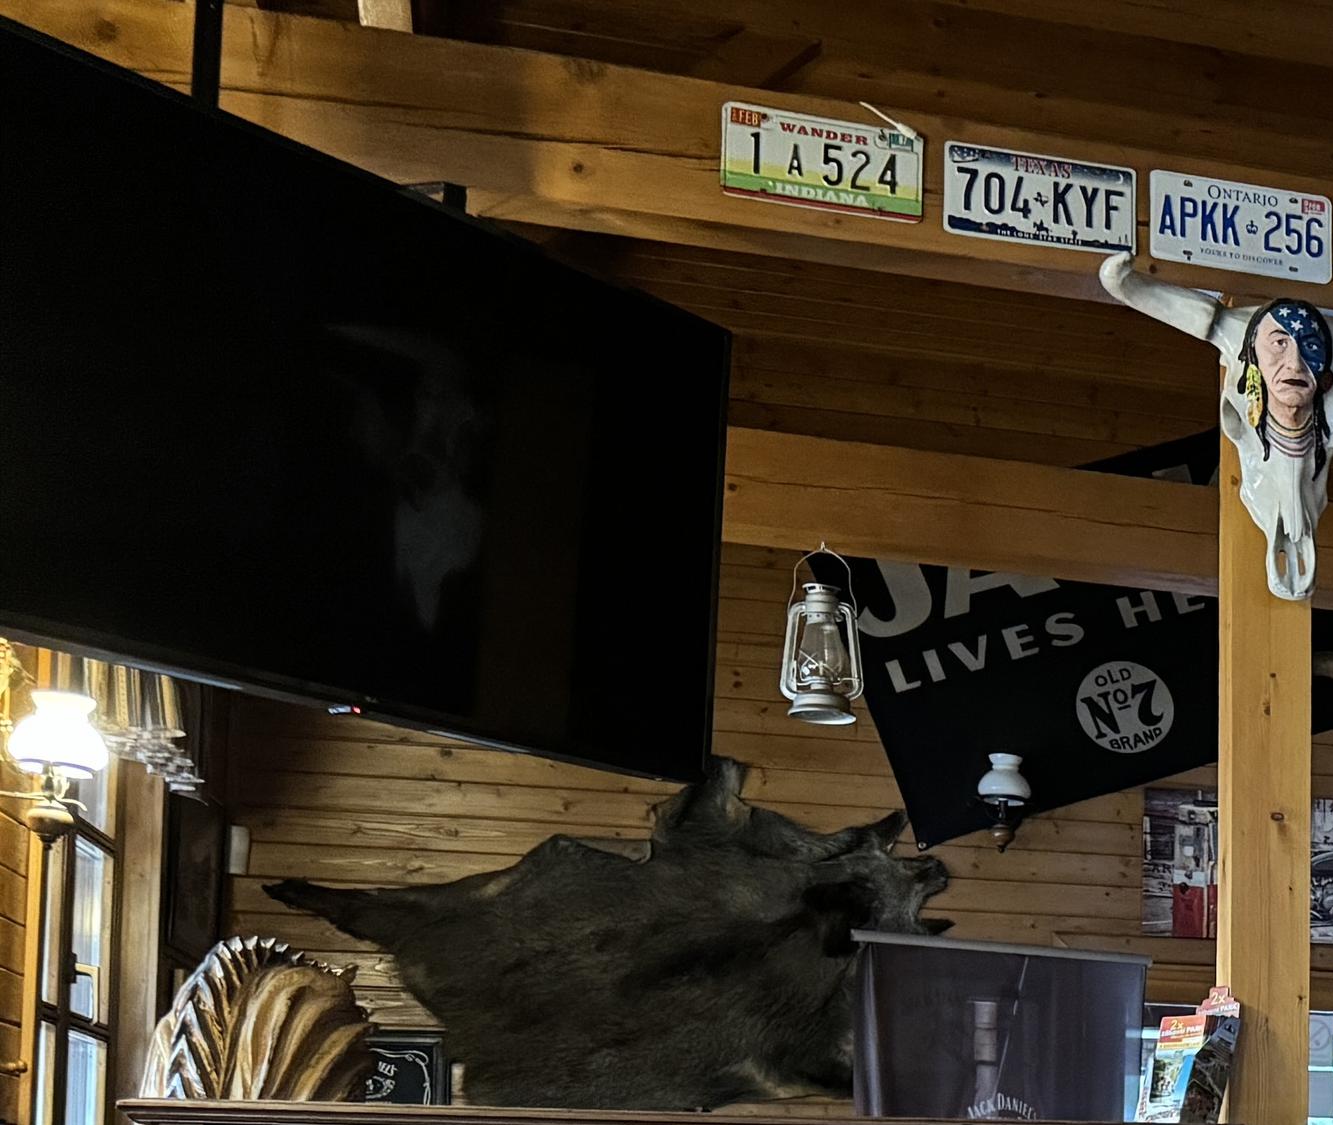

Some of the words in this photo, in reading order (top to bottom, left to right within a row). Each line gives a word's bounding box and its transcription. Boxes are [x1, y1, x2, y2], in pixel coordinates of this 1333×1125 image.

[738, 109, 758, 126] FEB
[779, 121, 869, 146] WANDER
[822, 143, 898, 195] 524
[1011, 156, 1073, 179] TEXAS
[774, 181, 870, 208] INDIANA
[1207, 184, 1279, 208] ONTARIO
[884, 611, 1086, 694] LIVES
[1095, 667, 1132, 688] OLD
[1108, 726, 1163, 751] BRAND
